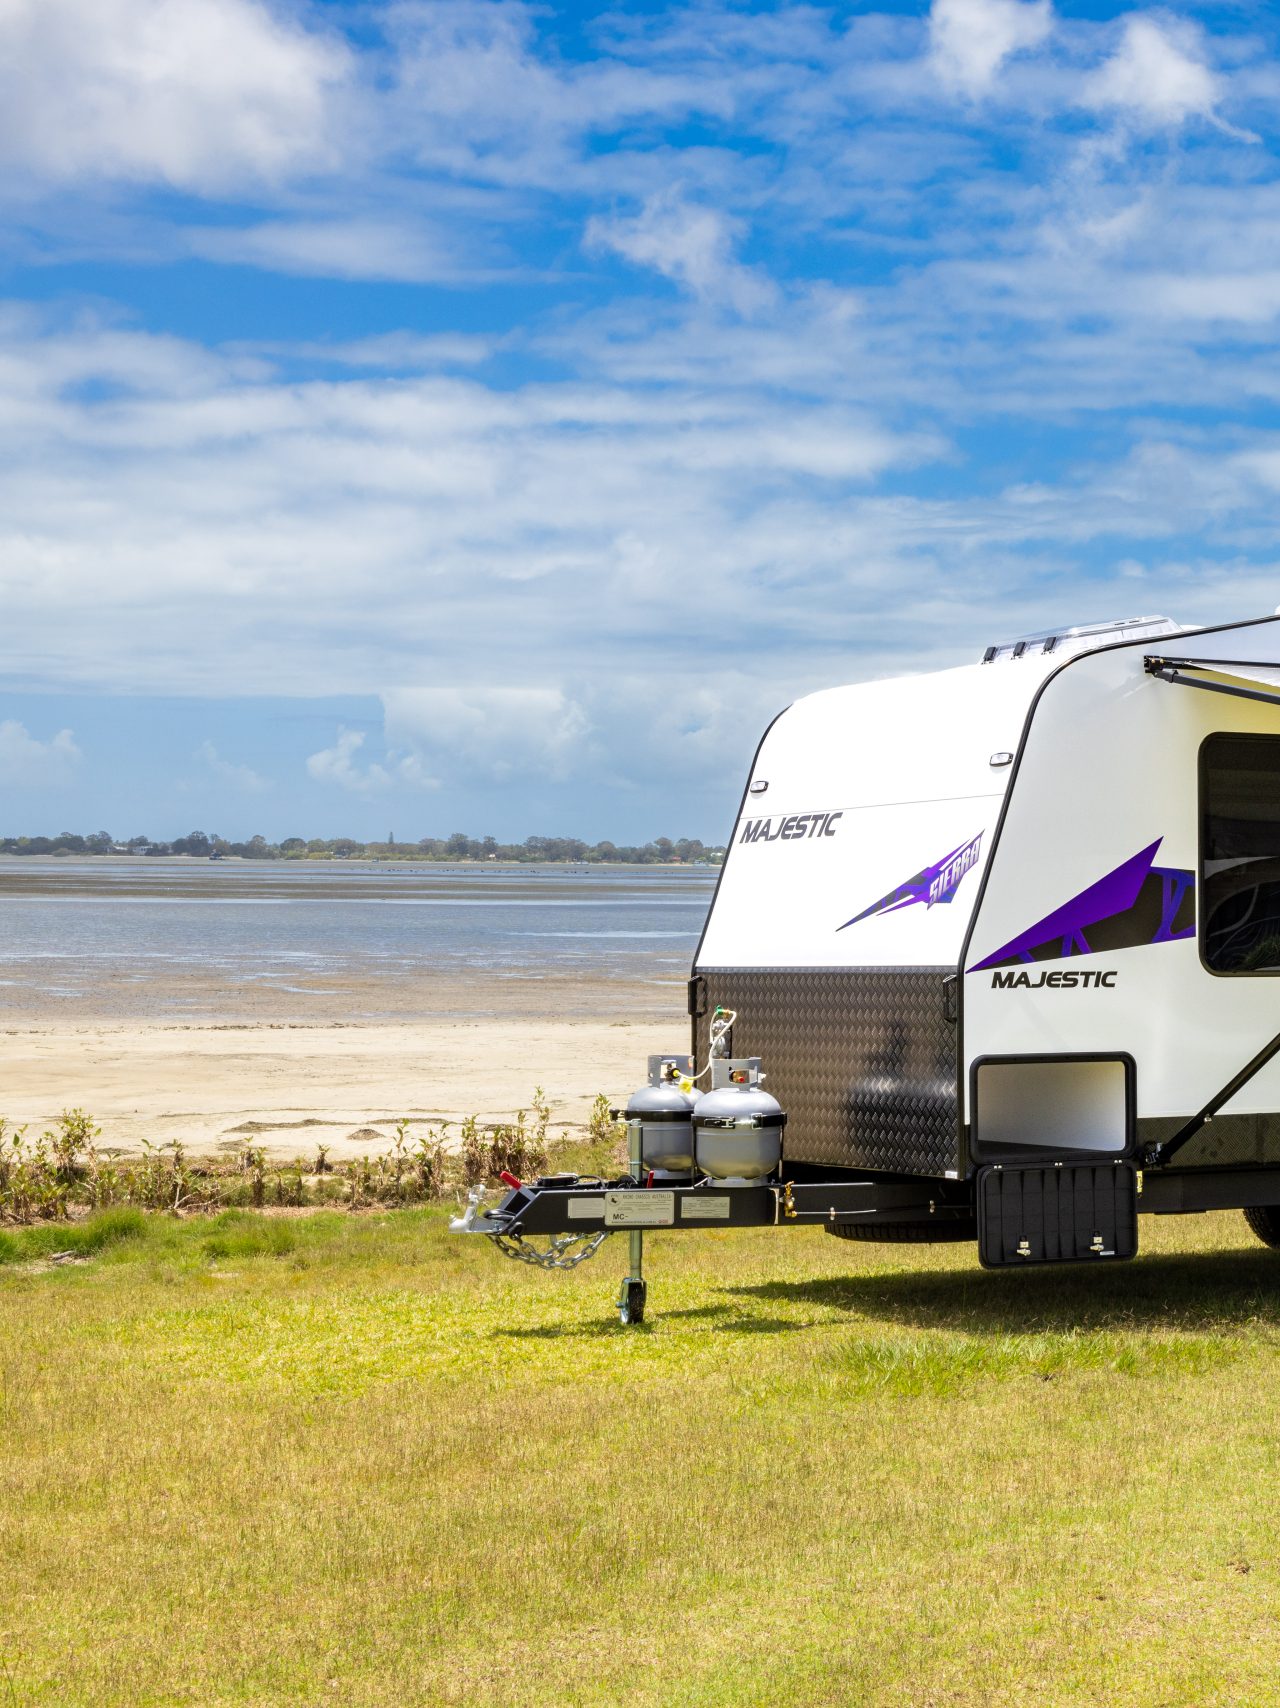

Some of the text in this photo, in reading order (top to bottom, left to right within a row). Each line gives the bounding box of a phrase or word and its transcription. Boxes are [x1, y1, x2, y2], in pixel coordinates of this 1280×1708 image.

[739, 811, 844, 844] MAJESTIC
[929, 836, 982, 904] SIERRA
[991, 971, 1118, 989] MAJESTIC
